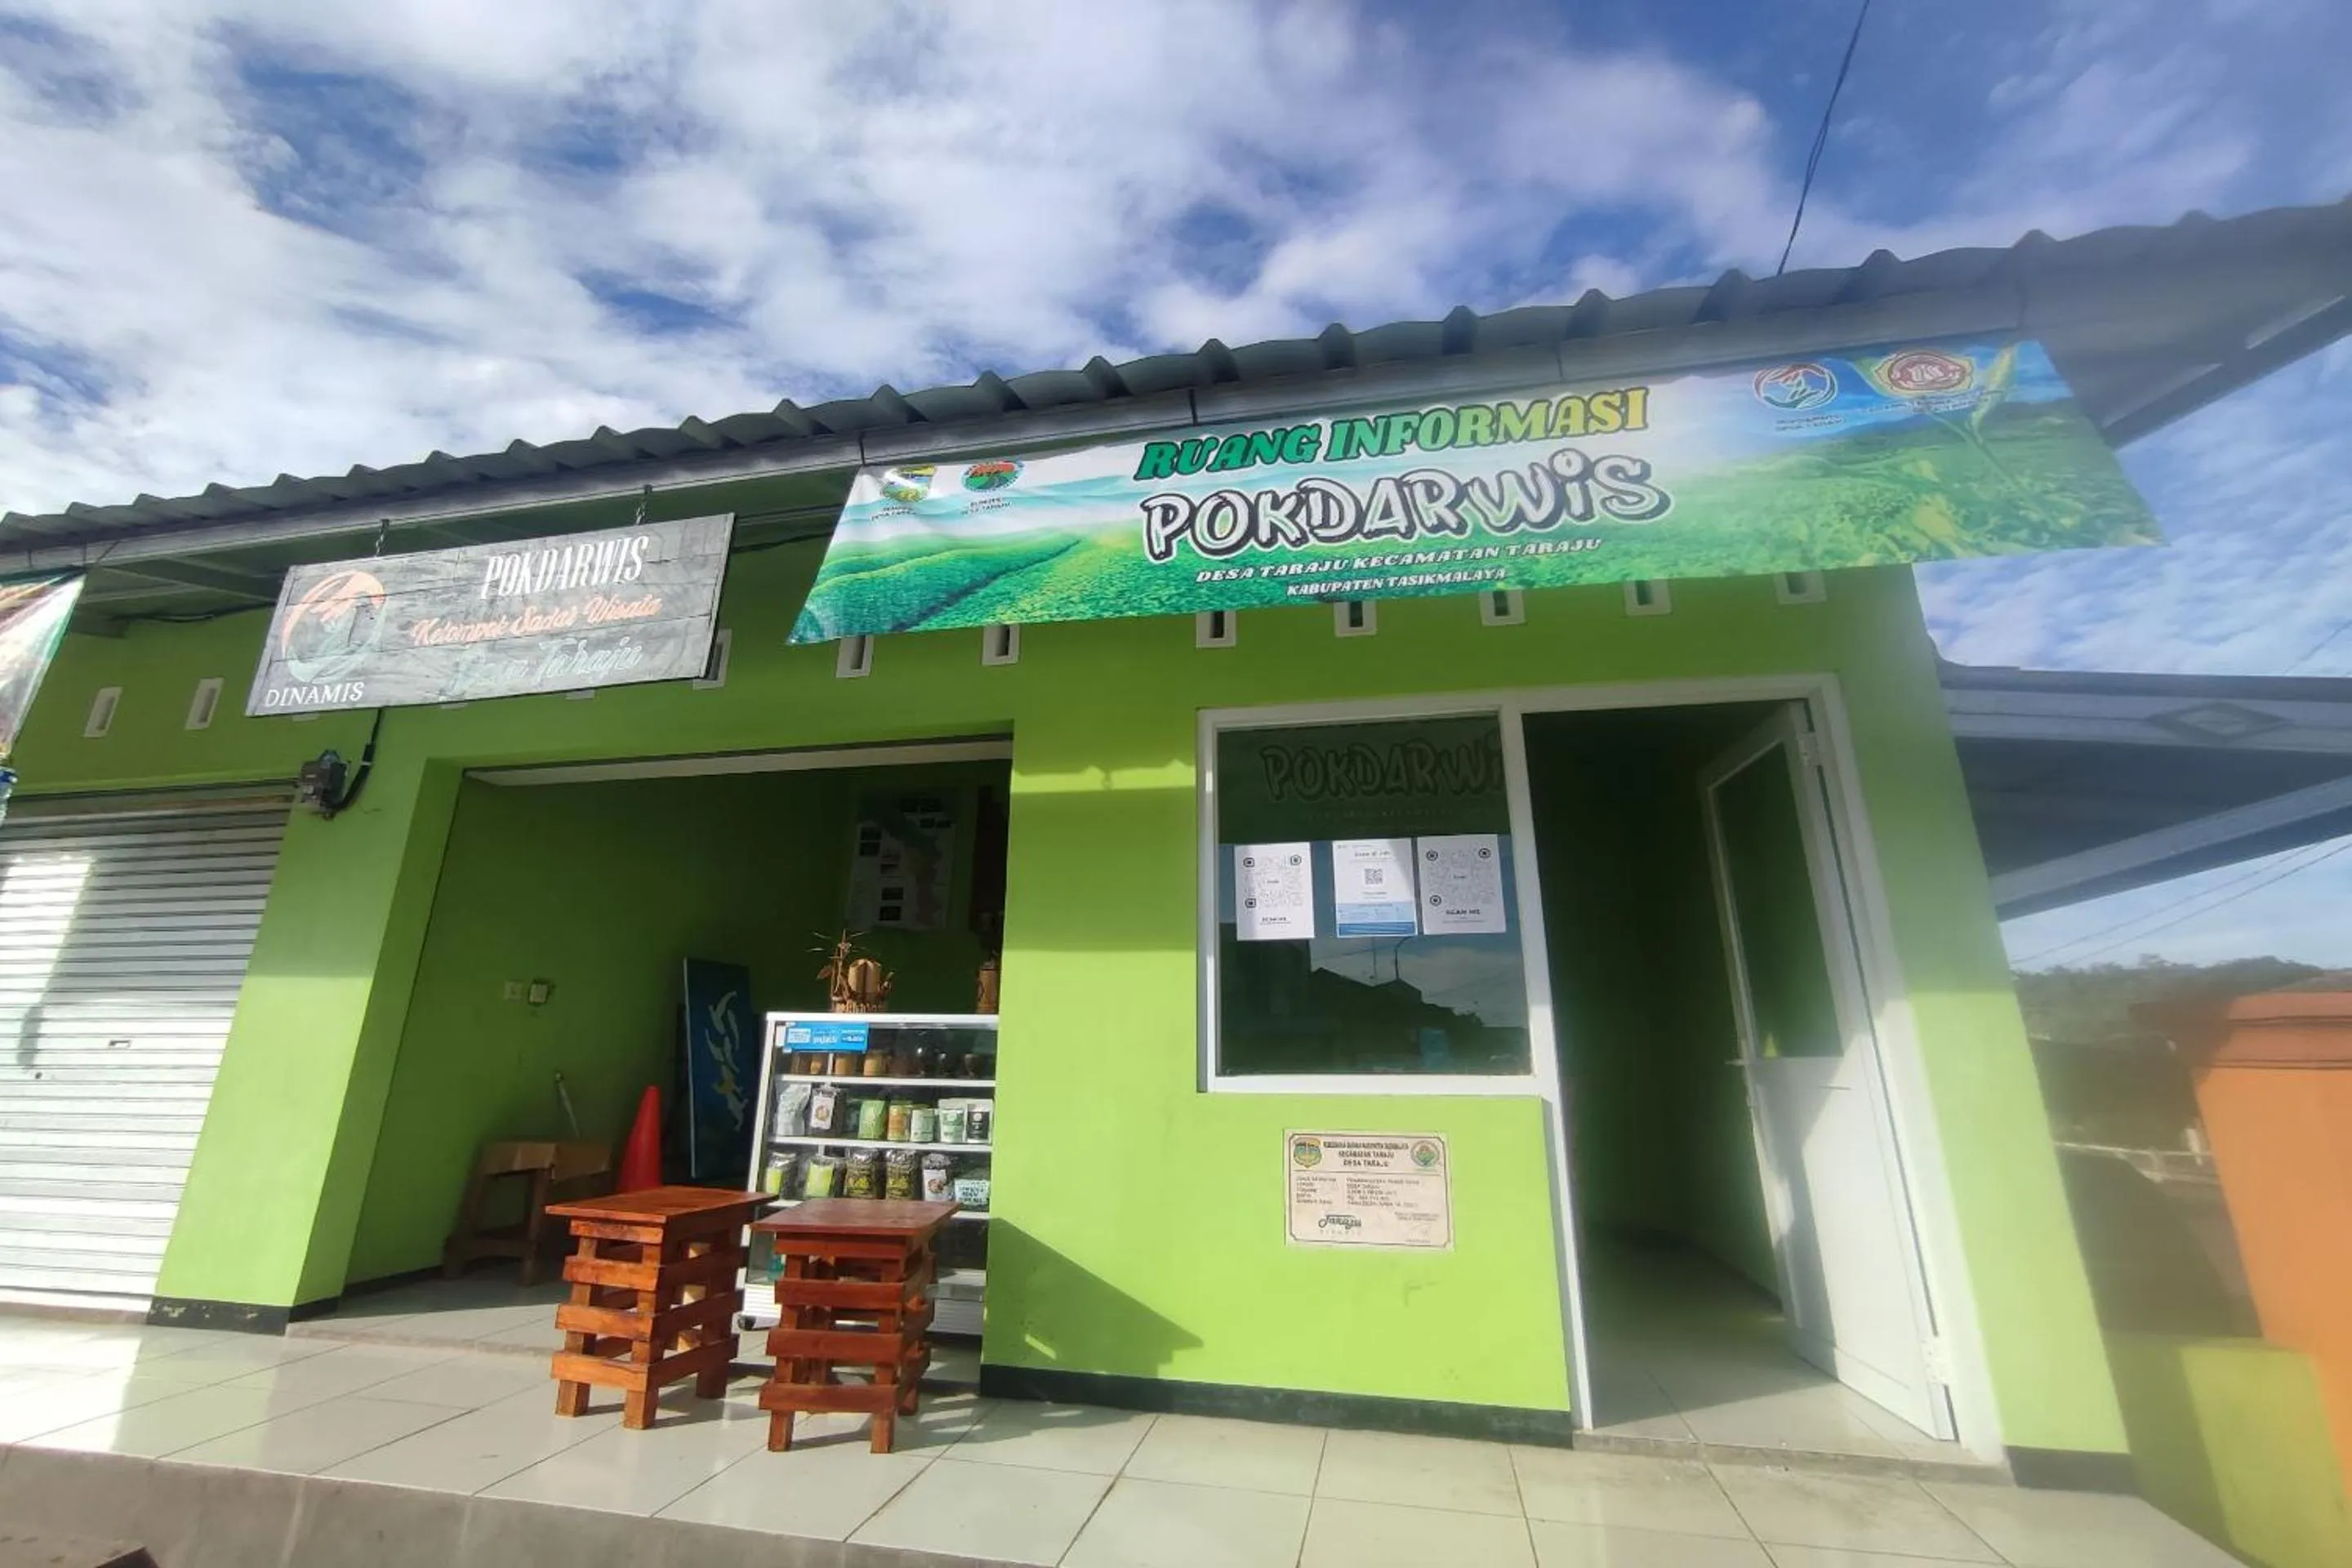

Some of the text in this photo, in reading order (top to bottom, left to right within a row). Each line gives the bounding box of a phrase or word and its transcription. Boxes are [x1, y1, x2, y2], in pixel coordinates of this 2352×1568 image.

[1134, 387, 1649, 481] RUANG INFORMASI
[480, 536, 649, 599] POKDARWIS
[1196, 538, 1603, 582] DESA TARAJU KECAMATAN TARAJU
[1286, 568, 1507, 596] KABUPATEN TASIKMALAYA
[585, 594, 662, 624] Wisata
[263, 681, 366, 708] DINAMIS
